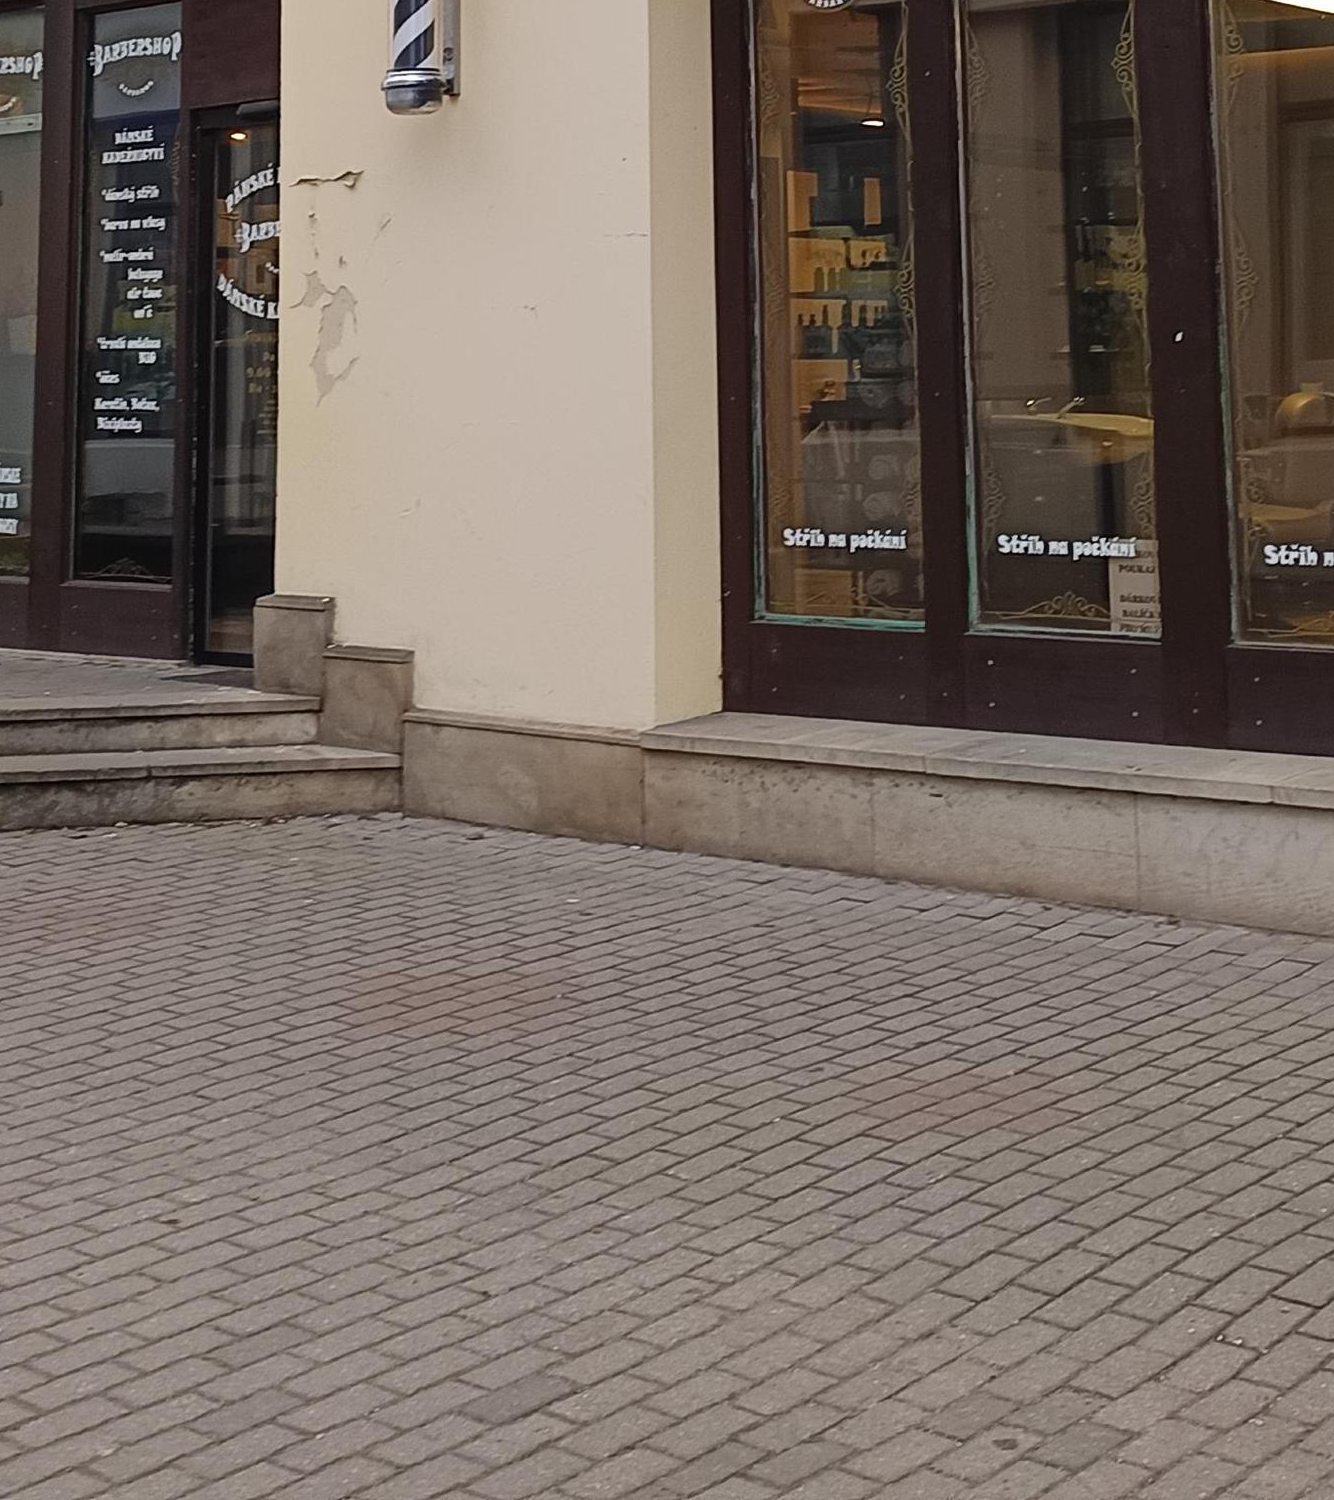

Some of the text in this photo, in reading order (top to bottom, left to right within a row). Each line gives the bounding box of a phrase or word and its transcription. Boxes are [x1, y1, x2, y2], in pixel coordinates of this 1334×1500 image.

[93, 31, 182, 77] BARBERSHOP
[783, 528, 907, 552] Střih na počkání
[997, 534, 1045, 555] Střih
[1049, 541, 1068, 556] na
[1072, 535, 1137, 562] počkání
[1264, 543, 1318, 567] Střih
